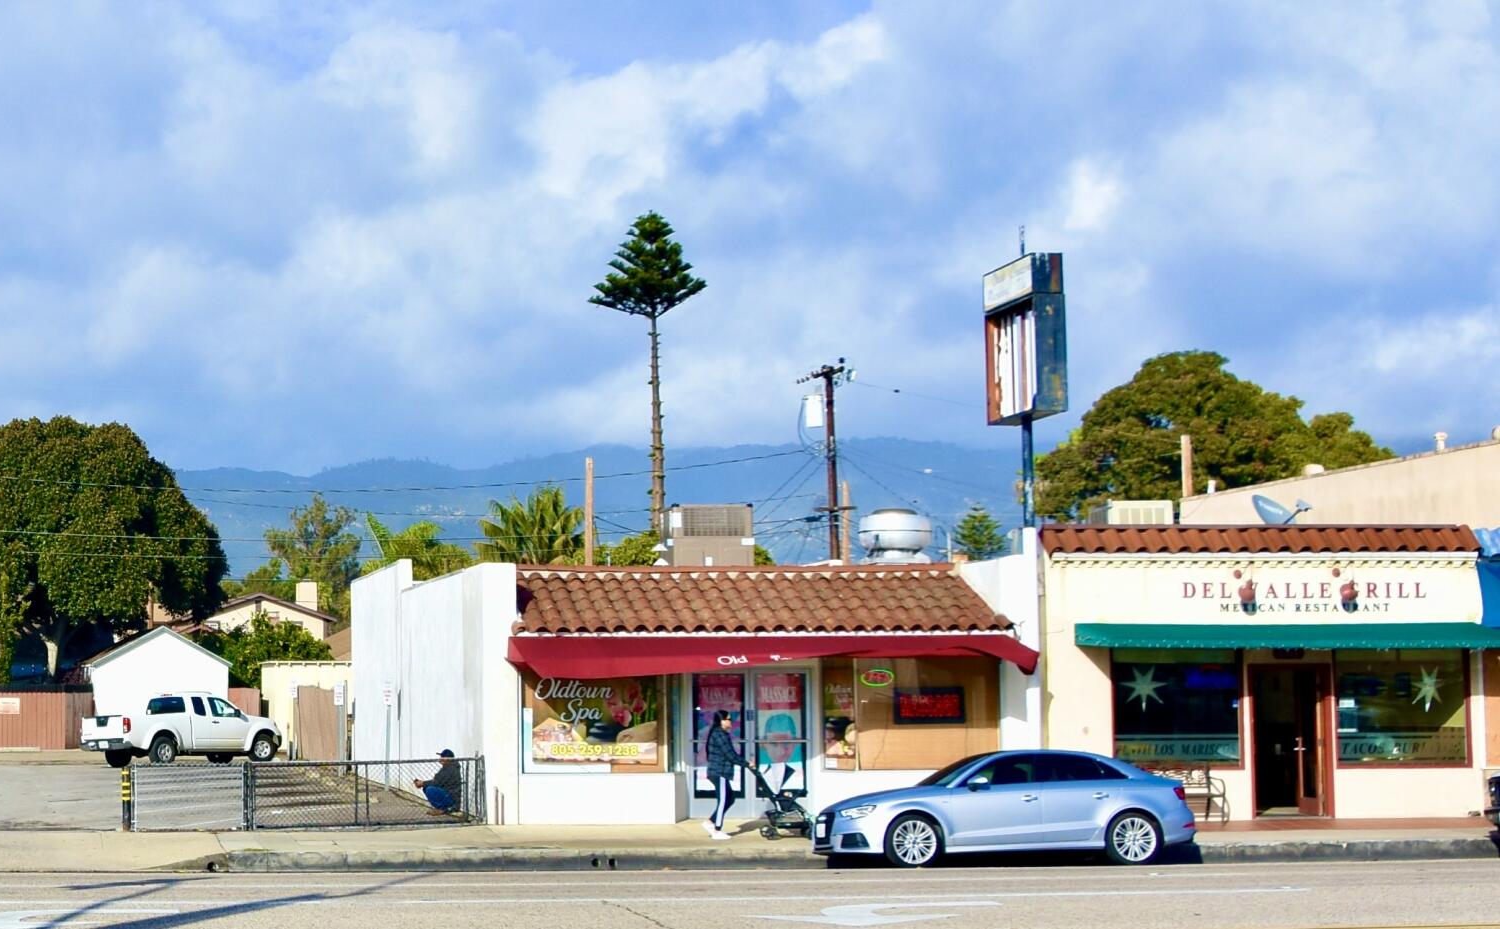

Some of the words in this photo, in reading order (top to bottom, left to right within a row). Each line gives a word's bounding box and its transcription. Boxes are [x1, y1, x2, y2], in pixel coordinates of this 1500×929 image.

[1182, 582, 1232, 599] DEL
[1343, 582, 1427, 599] RILL
[717, 656, 748, 665] Old
[534, 677, 614, 700] Oldtown
[760, 686, 797, 702] MASSAGE
[560, 698, 604, 727] Spa
[1342, 742, 1385, 754] TACOS
